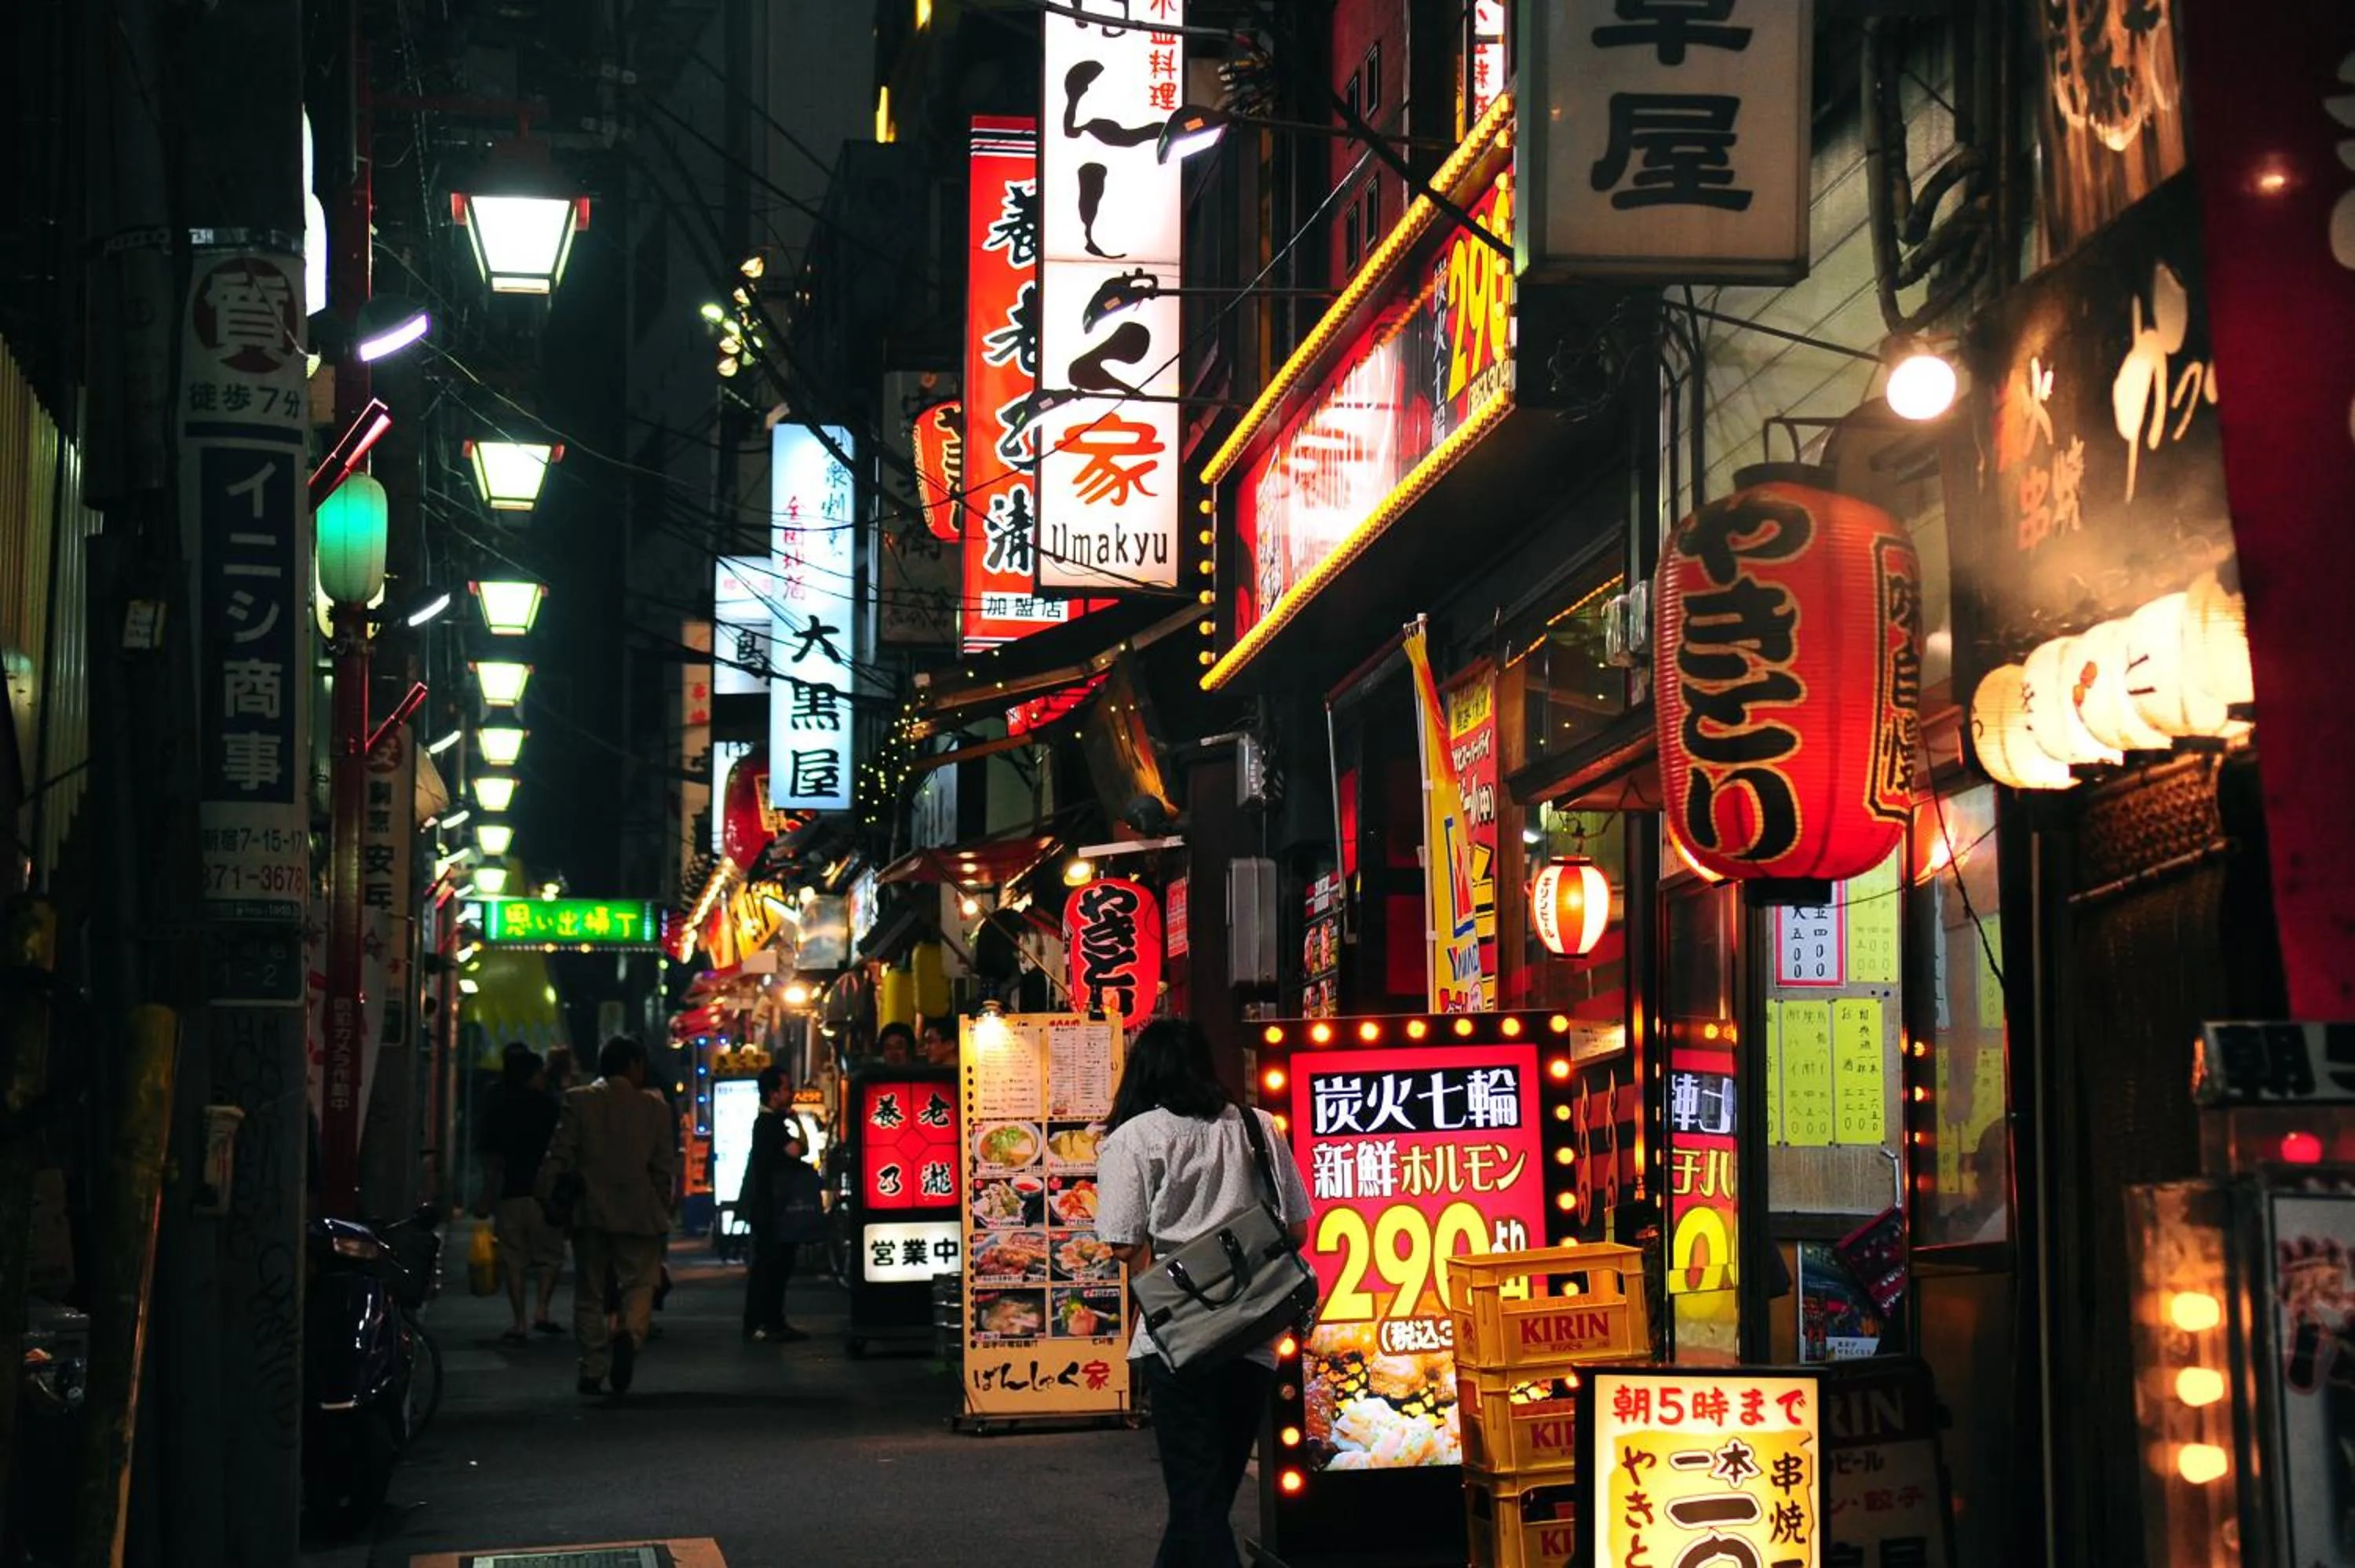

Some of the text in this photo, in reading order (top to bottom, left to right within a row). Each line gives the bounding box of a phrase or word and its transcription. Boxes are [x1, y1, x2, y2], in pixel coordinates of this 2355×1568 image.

[188, 381, 301, 420] 徒歩7分
[1051, 523, 1168, 567] Umakyu
[221, 461, 283, 792] イニシ商事
[984, 593, 1064, 619] 加盟店
[1678, 499, 1815, 861] やきとり
[789, 614, 842, 799] 大黒屋
[505, 904, 637, 939] 思い出横丁
[1078, 884, 1139, 1018] やきとり
[870, 1092, 952, 1129] 養老
[1314, 1069, 1518, 1135] 炭火七輪
[877, 1161, 953, 1196] 乃瀧
[1312, 1140, 1527, 1199] 新鮮ホルモン
[871, 1238, 958, 1267] 営業中
[1316, 1202, 1492, 1322] 290
[1520, 1312, 1609, 1344] KIRIN
[973, 1359, 1112, 1394] ばんしゃく家
[1612, 1384, 1806, 1428] 朝5時まで
[1674, 1442, 1755, 1483] 一本
[1830, 1450, 1884, 1475] ビール
[1769, 1451, 1806, 1568] 串焼
